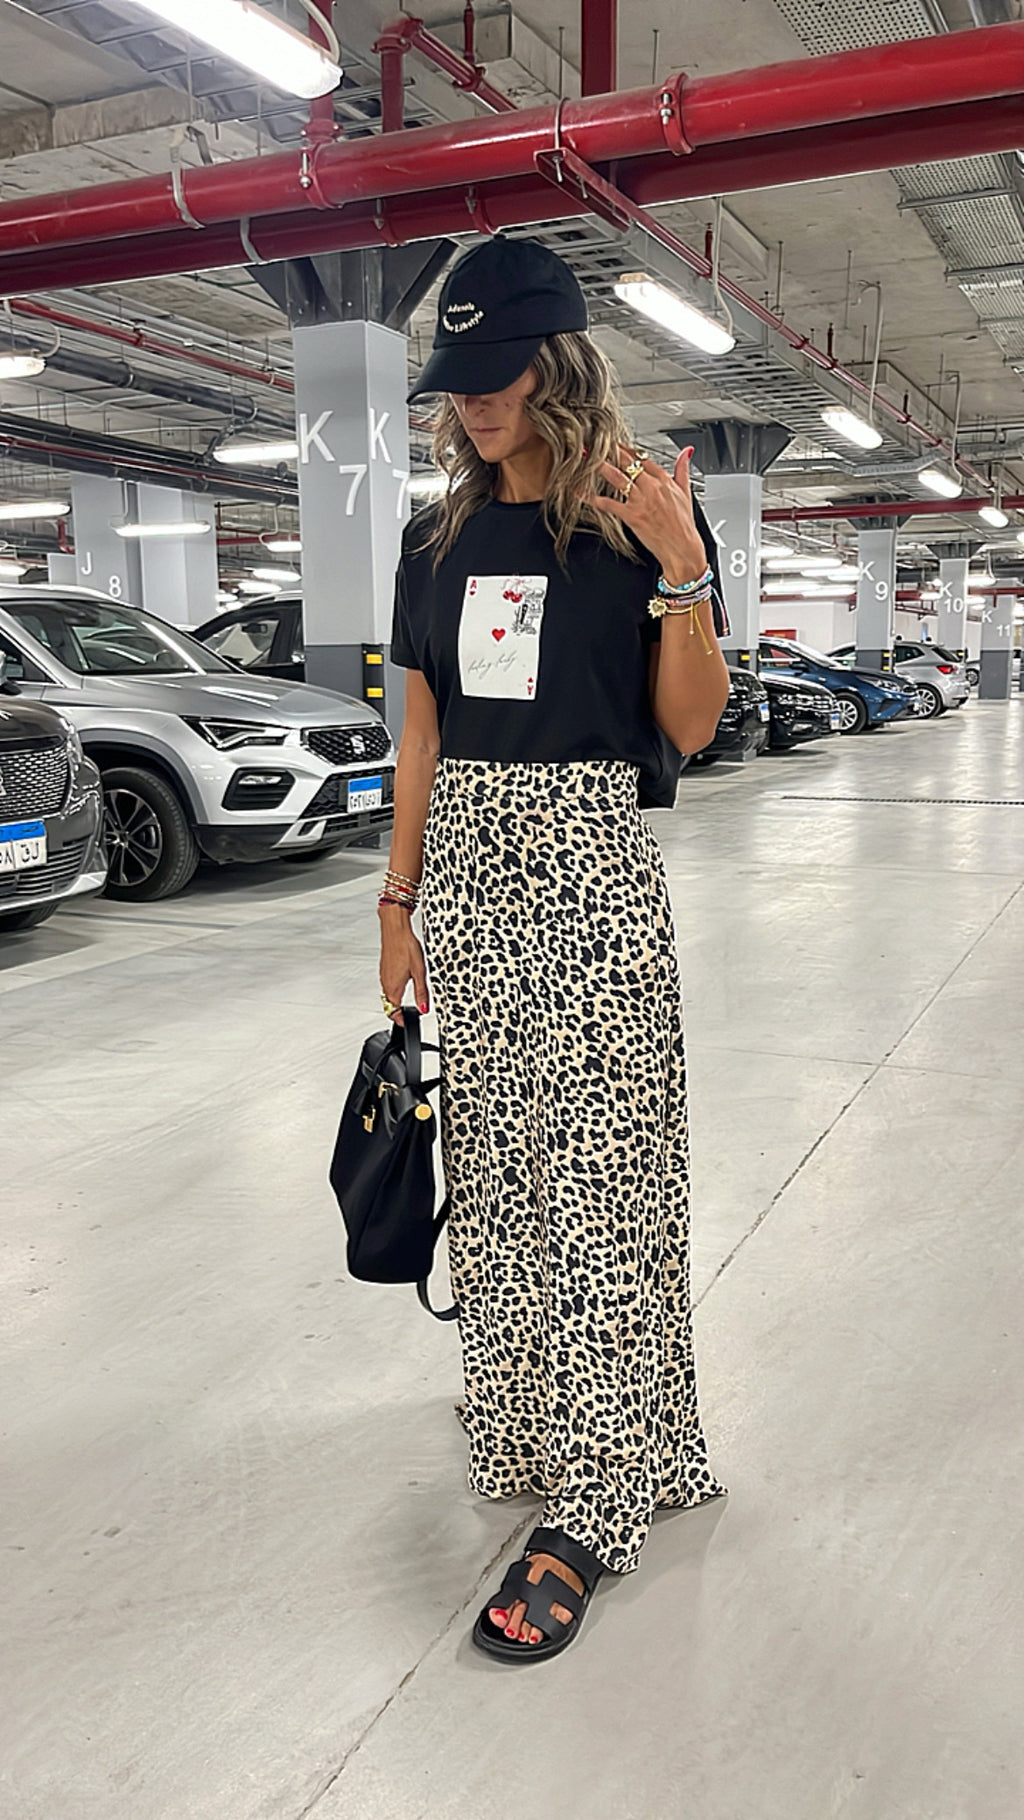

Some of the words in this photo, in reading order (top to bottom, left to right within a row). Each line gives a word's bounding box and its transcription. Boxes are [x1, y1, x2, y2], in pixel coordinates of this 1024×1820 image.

[299, 410, 336, 464] K
[368, 407, 392, 463] K
[339, 464, 368, 516] 7
[391, 468, 409, 519] 7
[80, 551, 92, 575] J
[729, 549, 747, 577] 8
[858, 560, 875, 581] K
[109, 575, 121, 598] 8
[469, 579, 477, 589] A
[874, 581, 889, 601] 9
[940, 581, 953, 598] K
[943, 597, 964, 613] 10
[981, 610, 993, 624] K
[996, 624, 1011, 638] 11
